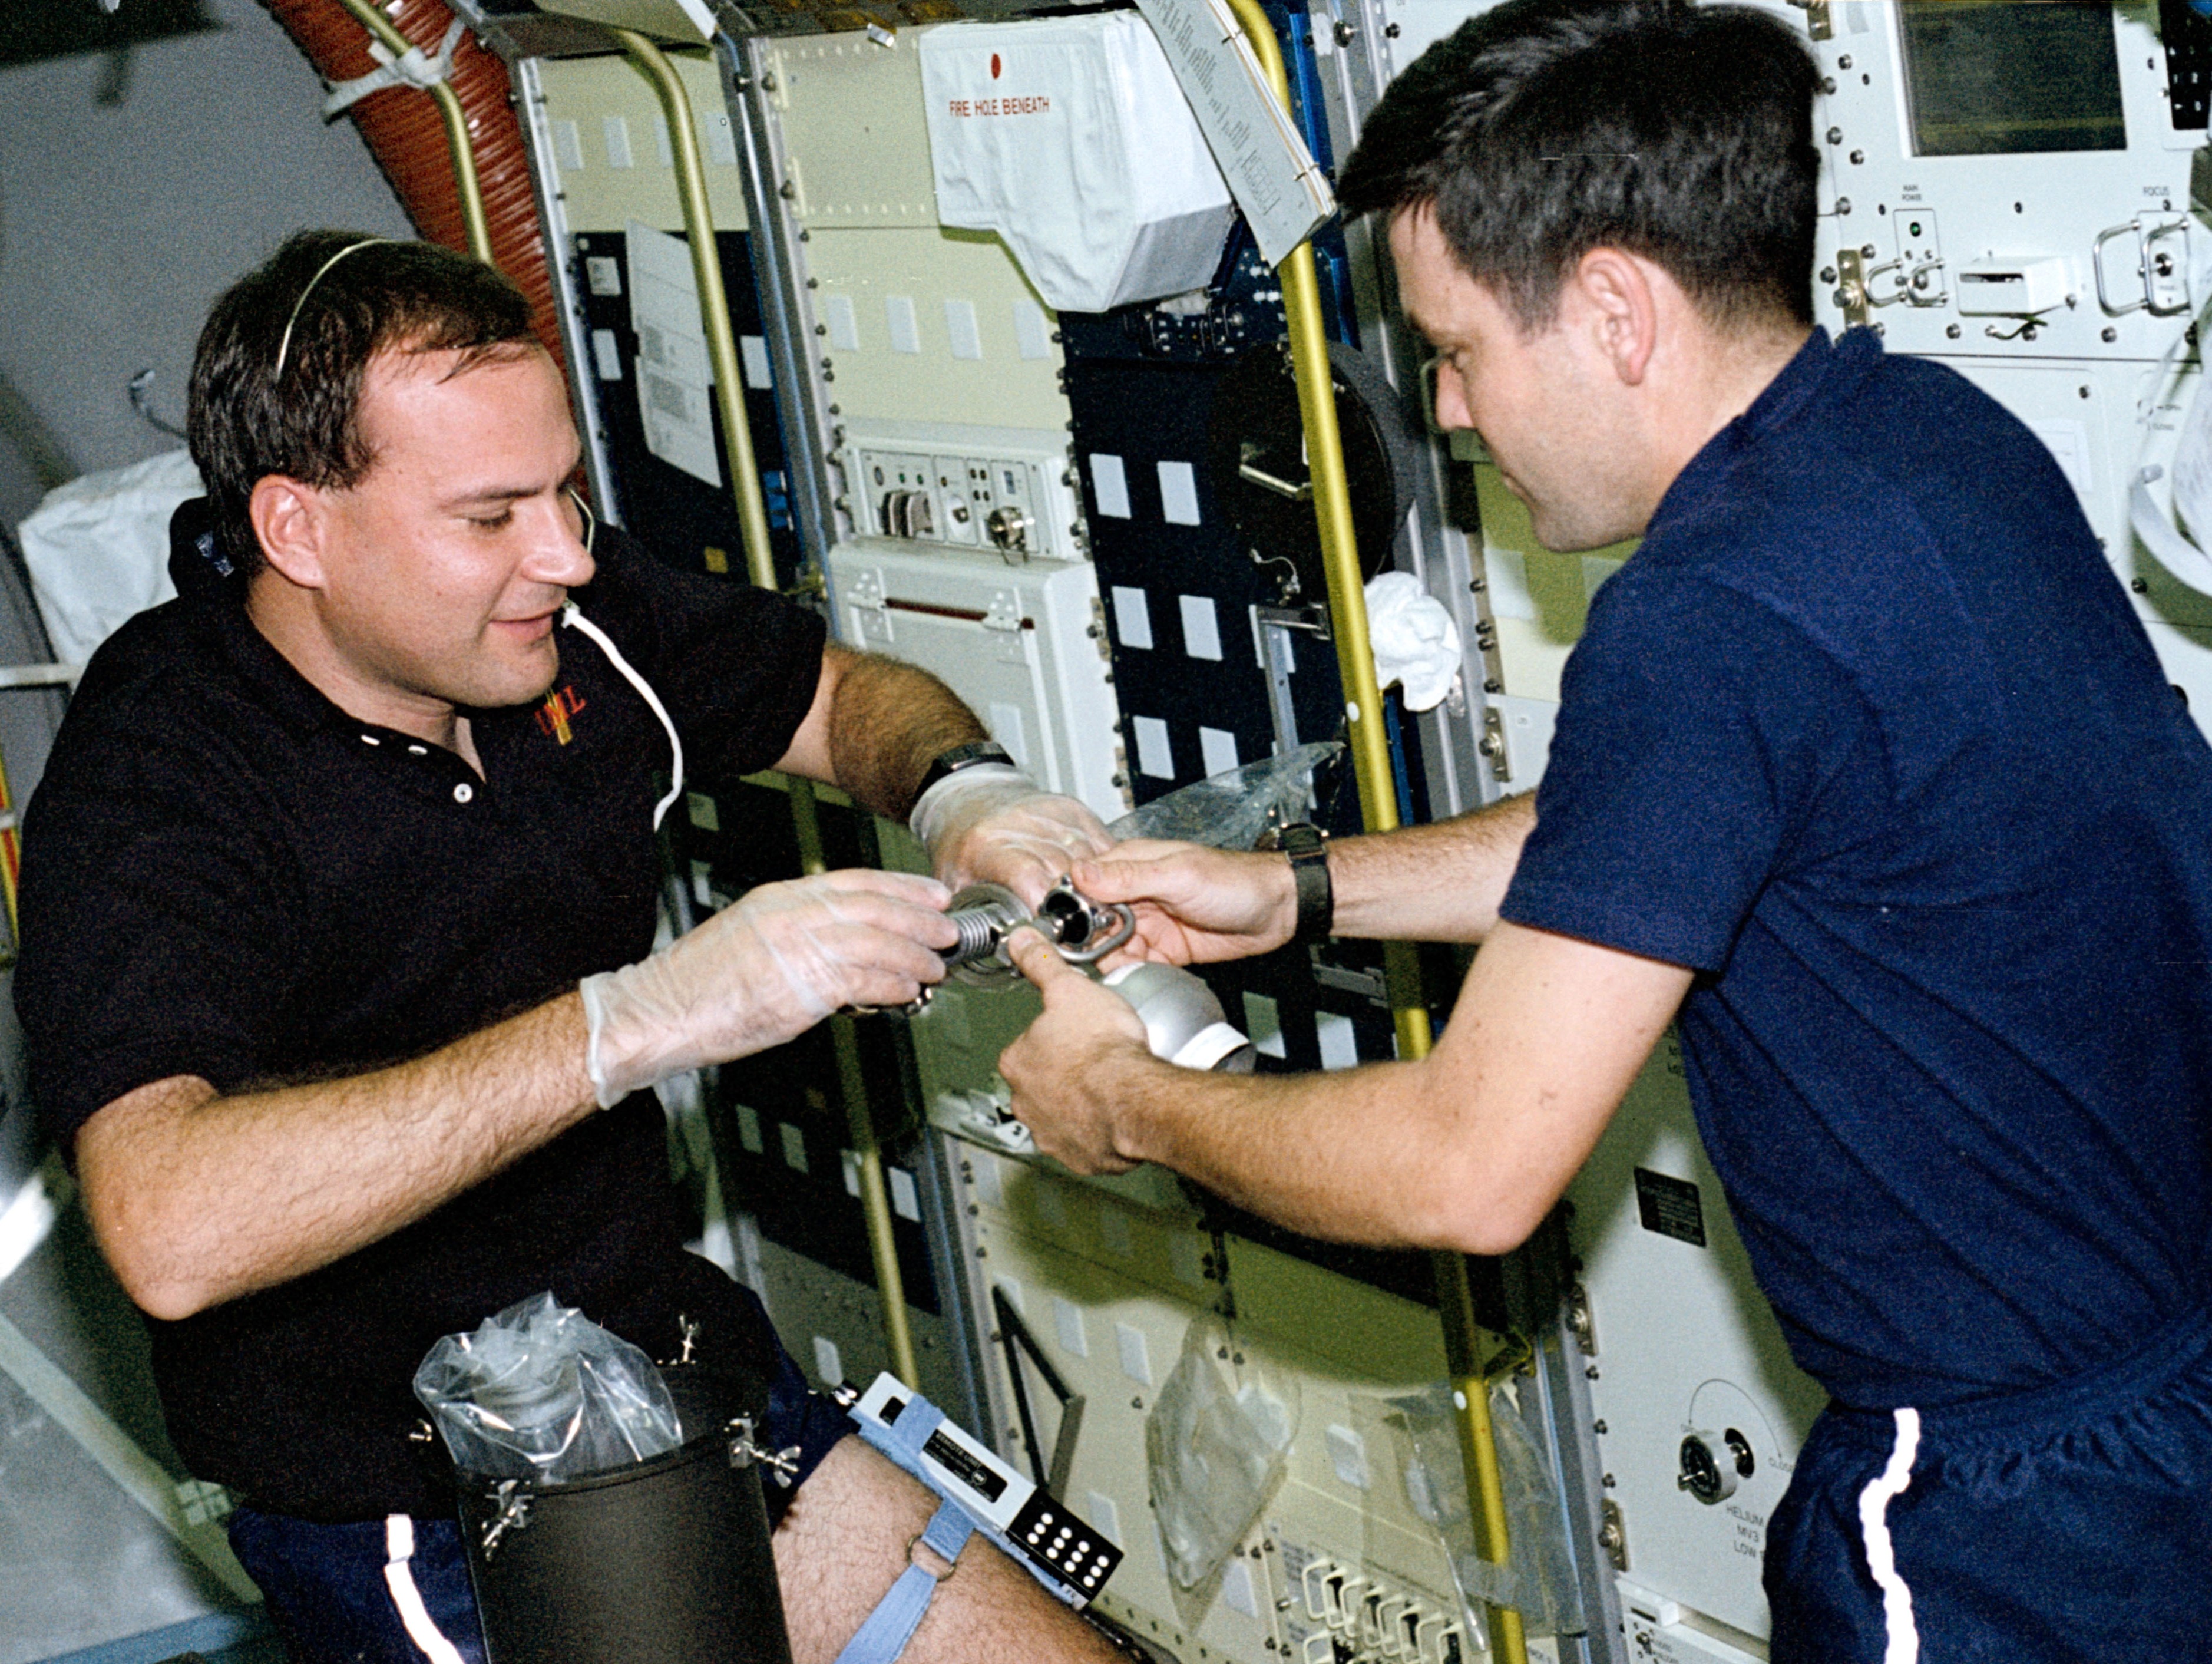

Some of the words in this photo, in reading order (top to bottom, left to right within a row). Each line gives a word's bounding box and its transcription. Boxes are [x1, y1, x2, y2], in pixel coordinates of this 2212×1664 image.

[950, 100, 971, 117] FIRE
[974, 98, 998, 116] HOLE
[1003, 95, 1050, 115] BENEATH
[2143, 186, 2170, 196] FOCUS
[1726, 1505, 1764, 1527] HELIUM
[1737, 1525, 1759, 1543] MV3
[1733, 1540, 1757, 1559] LOW
